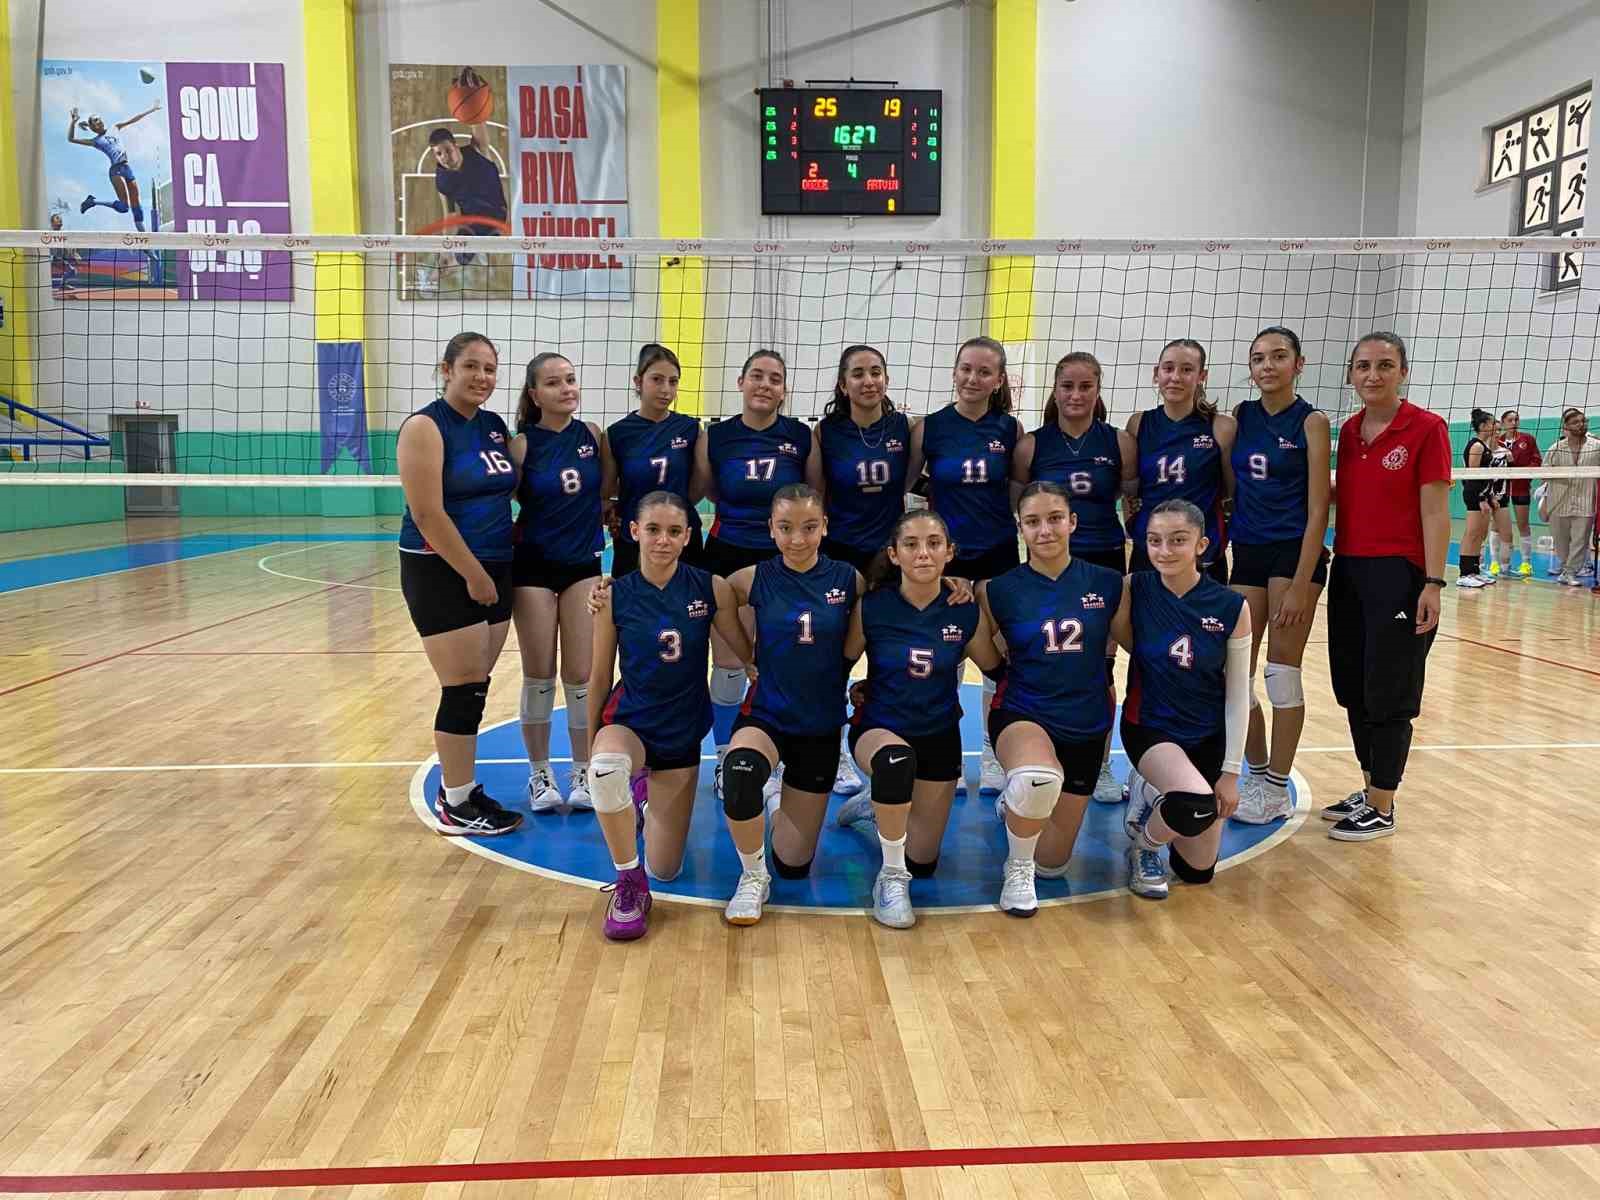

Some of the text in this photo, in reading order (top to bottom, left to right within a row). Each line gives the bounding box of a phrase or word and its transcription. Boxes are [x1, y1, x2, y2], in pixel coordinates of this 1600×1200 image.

[180, 86, 259, 141] SONU
[519, 85, 588, 144] BAŞA
[814, 97, 838, 117] 25
[884, 98, 901, 117] 19
[790, 121, 797, 131] 2
[912, 122, 918, 131] 2
[791, 136, 797, 145] 3
[912, 137, 918, 146] 3
[912, 151, 918, 160] 4
[183, 153, 224, 207] CA
[520, 152, 578, 204] RIYA
[808, 162, 819, 178] 2
[848, 163, 857, 178] 4
[890, 163, 896, 178] 1
[480, 451, 512, 475] 16
[651, 456, 668, 484] 7
[745, 458, 777, 481] 17
[856, 460, 890, 486] 10
[962, 458, 989, 484] 11
[1156, 454, 1187, 484] 14
[1249, 453, 1268, 480] 9
[560, 468, 582, 495] 8
[1070, 471, 1092, 494] 6
[797, 610, 815, 645] 1
[1040, 617, 1083, 654] 12
[658, 628, 682, 663] 3
[1168, 633, 1194, 670] 4
[909, 647, 933, 679] 5
